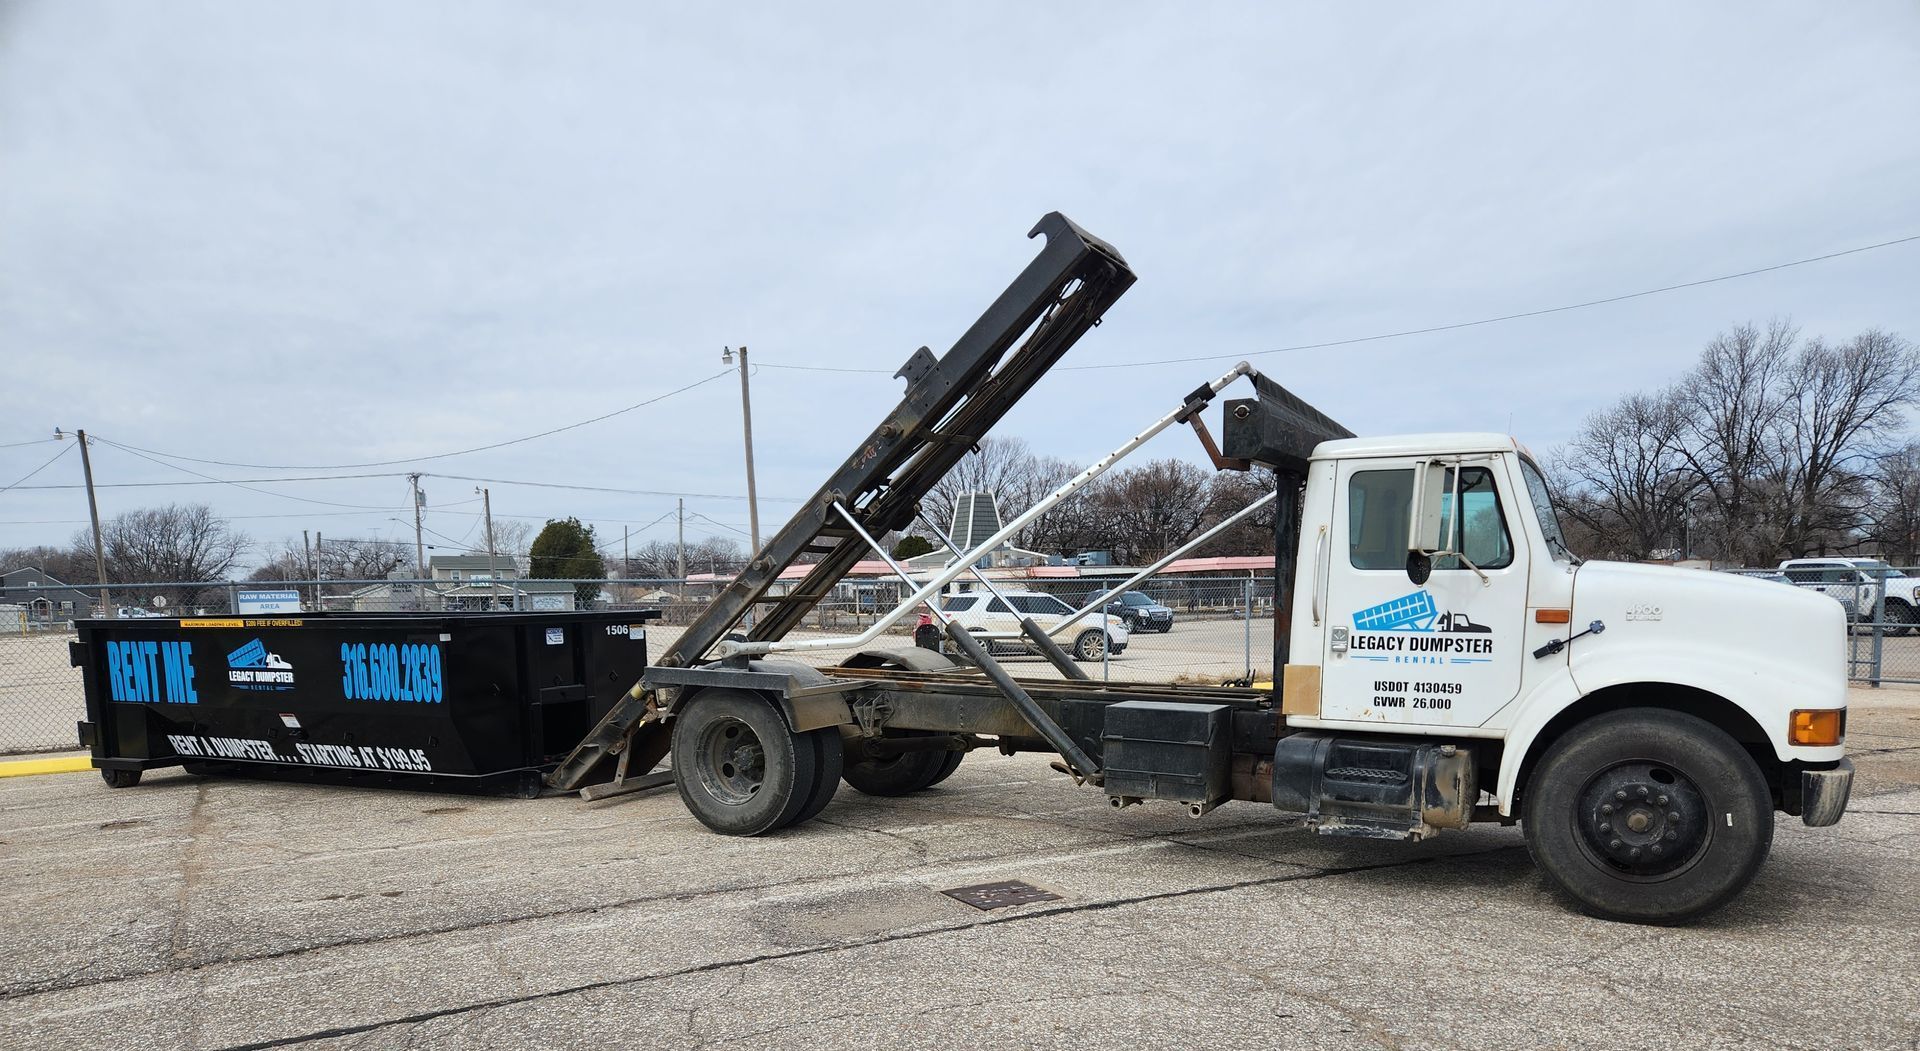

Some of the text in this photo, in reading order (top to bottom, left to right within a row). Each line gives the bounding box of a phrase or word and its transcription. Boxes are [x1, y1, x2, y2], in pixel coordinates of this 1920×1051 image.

[240, 592, 298, 600] RAW MATERIAL
[605, 625, 628, 635] 1506
[1350, 636, 1493, 653] LEGACY DUMPSTER
[1395, 656, 1444, 665] RENTAL
[106, 641, 198, 704] RENT ME
[228, 670, 295, 683] LEGACY DUMPSTER
[341, 642, 443, 703] 316.680.2839
[1374, 681, 1462, 694] USDOT 4130459
[1373, 696, 1406, 708] GVWR
[167, 735, 204, 756] RENT
[200, 736, 217, 756] A
[295, 742, 361, 767] STARTING
[358, 746, 380, 768] AT
[376, 746, 432, 772] $199.95
